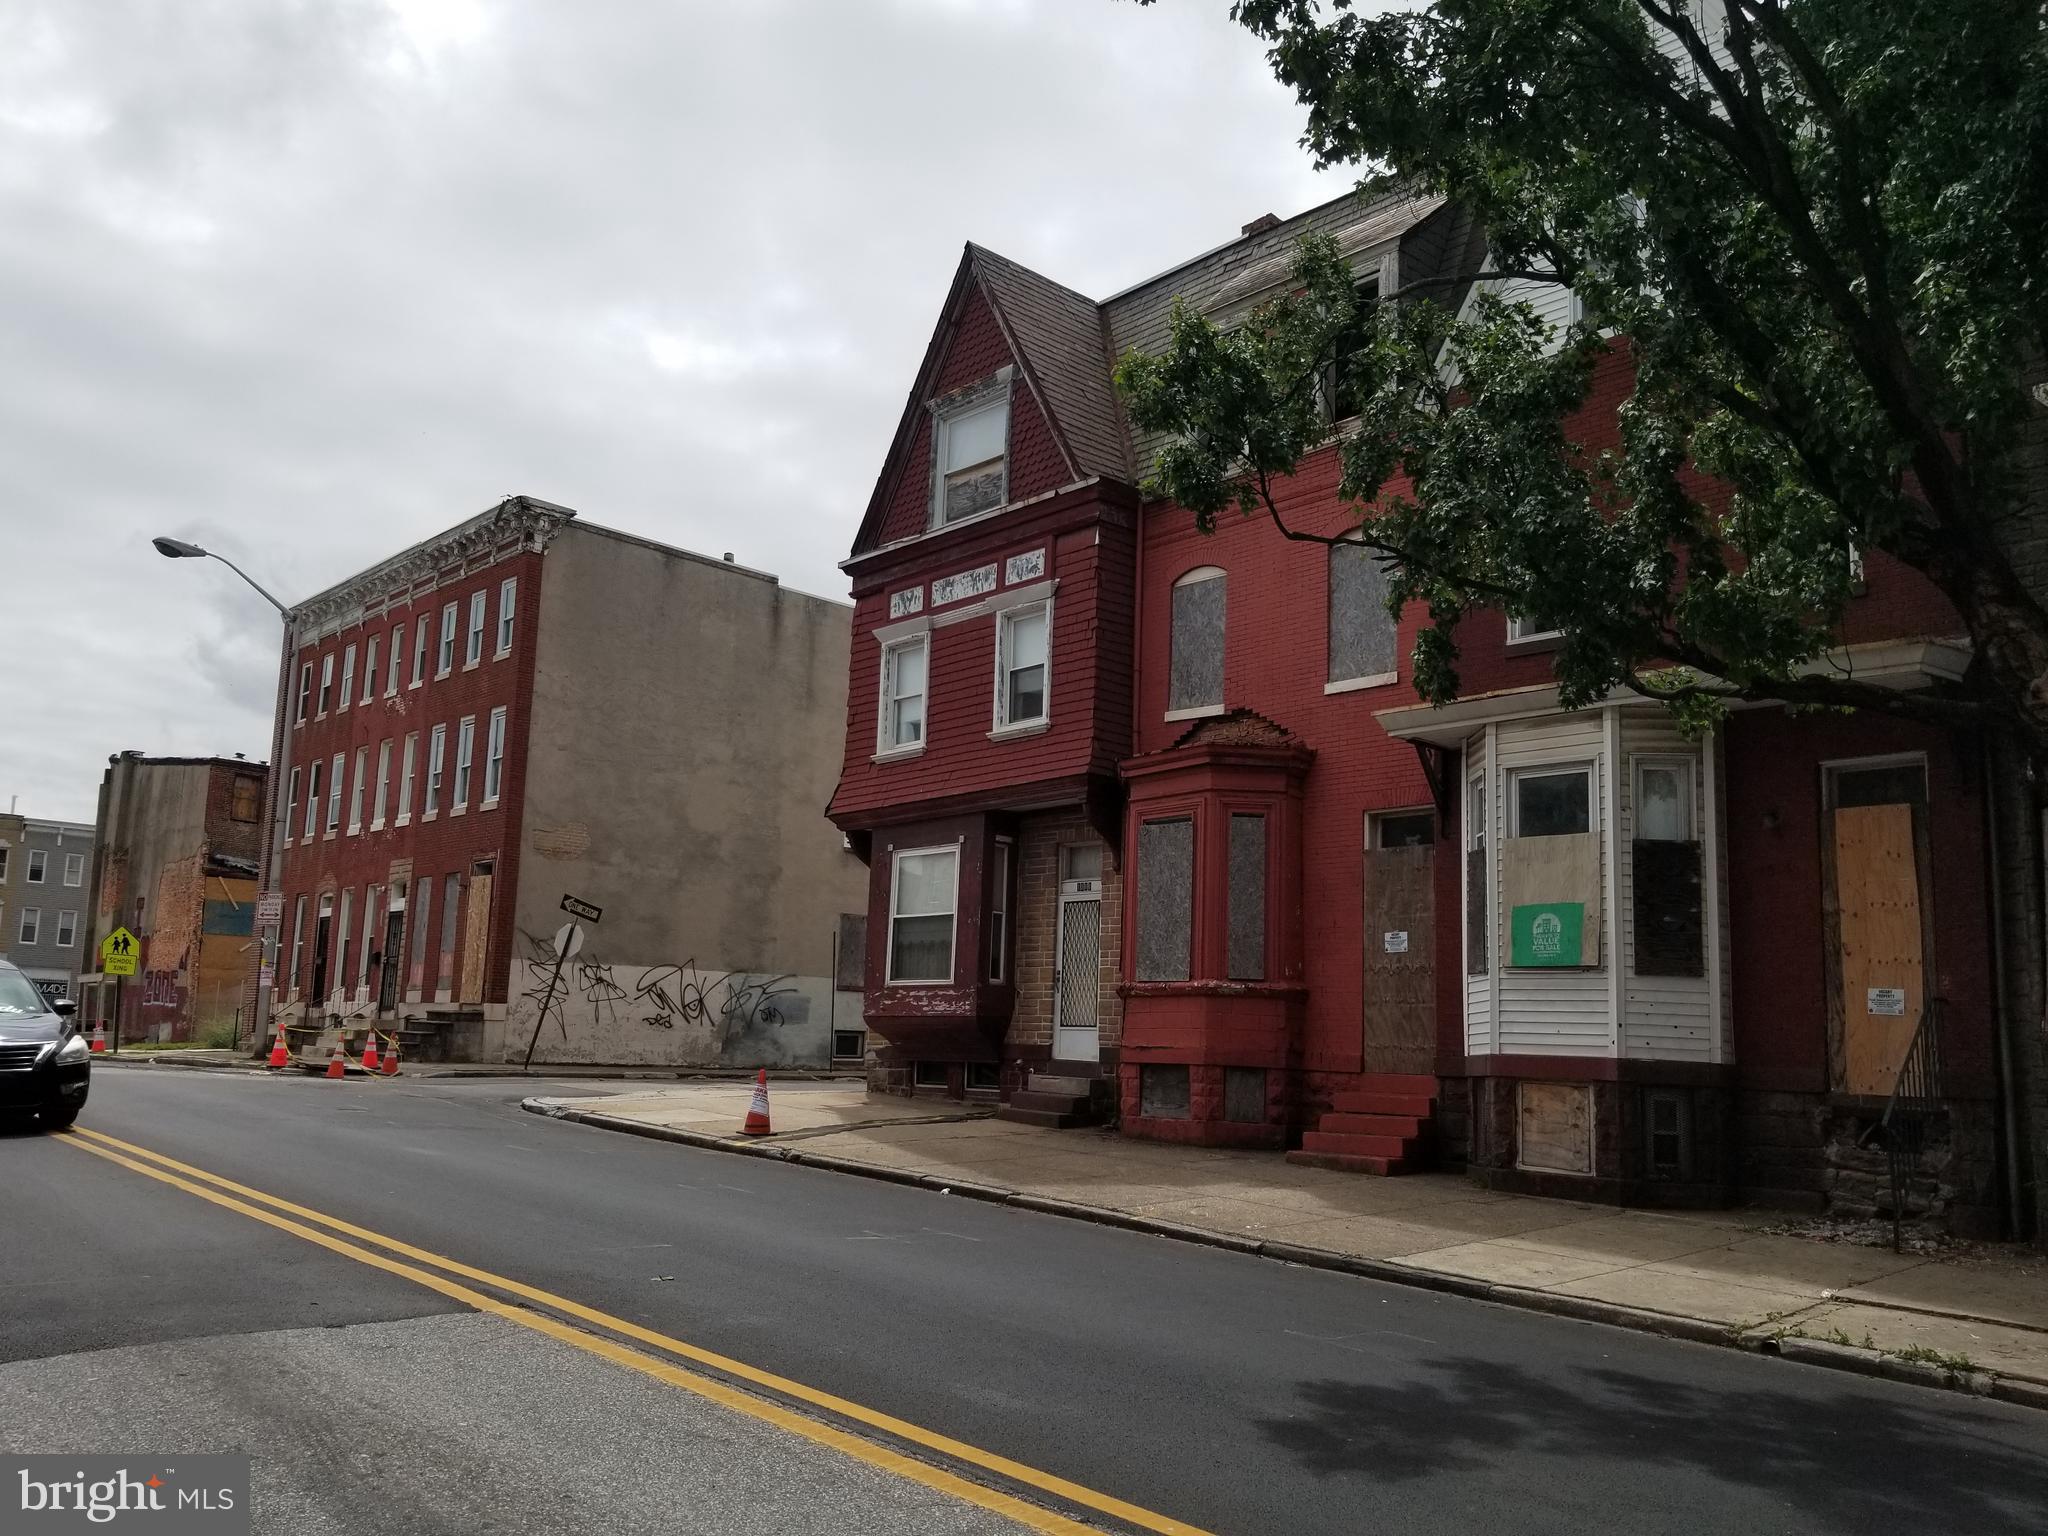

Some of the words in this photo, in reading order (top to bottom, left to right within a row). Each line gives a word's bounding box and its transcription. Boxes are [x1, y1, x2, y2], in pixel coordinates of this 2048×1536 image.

[568, 901, 580, 910] ONE
[581, 906, 594, 915] WAY
[109, 956, 133, 965] SCHOOL
